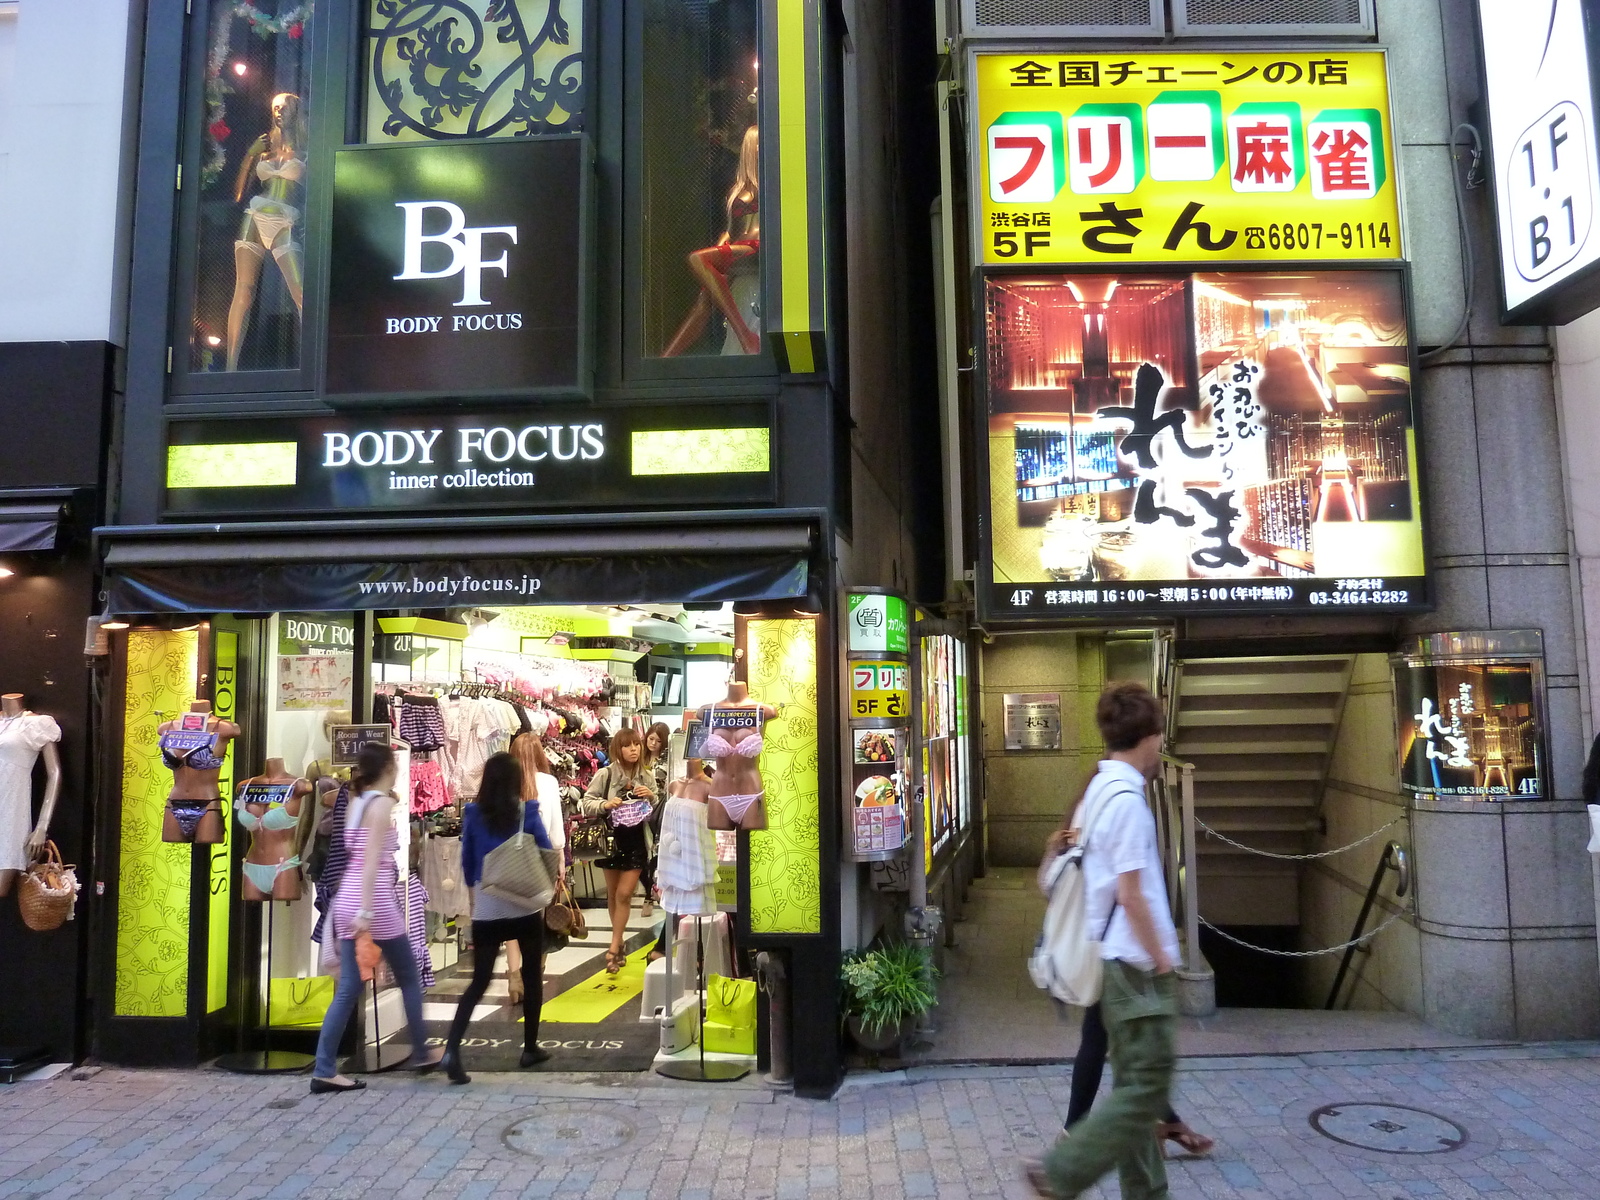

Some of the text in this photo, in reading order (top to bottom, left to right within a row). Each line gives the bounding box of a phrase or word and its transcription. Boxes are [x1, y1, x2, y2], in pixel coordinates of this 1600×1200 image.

[1009, 59, 1349, 87] 全国チェーンの店
[994, 121, 1370, 195] フリー麻雀
[991, 212, 1051, 227] 渋谷店
[1079, 201, 1238, 254] さん
[993, 231, 1051, 258] 5F
[386, 313, 523, 334] BODY FOCUS
[322, 424, 605, 467] BODY FOCUS
[389, 468, 535, 490] inner collection
[359, 575, 542, 596] www.bodyfocus.jp
[851, 596, 862, 604] 2F
[1010, 589, 1033, 606] 4F
[1044, 590, 1098, 605] 営業時間
[1309, 591, 1408, 605] 03-3464-8282
[287, 620, 327, 642] BODY
[857, 699, 878, 714] 5F
[1518, 778, 1540, 794] 4F
[520, 1039, 624, 1050] OCUS
